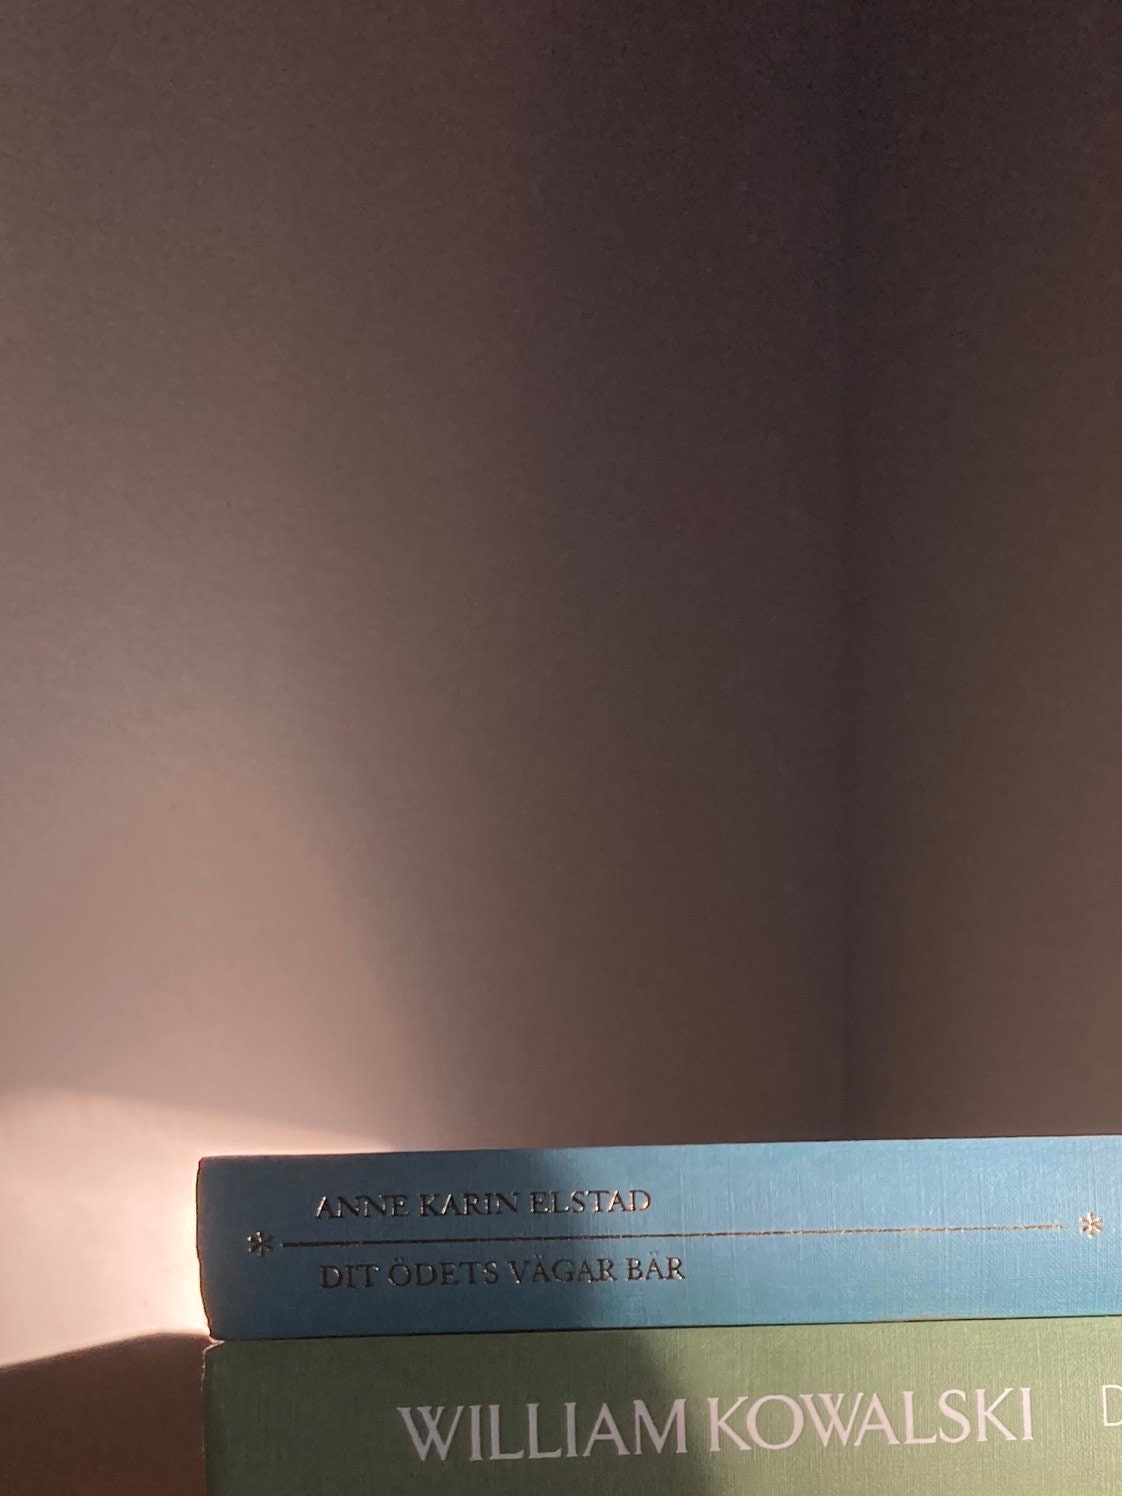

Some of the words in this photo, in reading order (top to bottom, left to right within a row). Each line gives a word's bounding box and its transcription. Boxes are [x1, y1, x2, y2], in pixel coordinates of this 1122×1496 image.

[315, 1194, 410, 1219] ANNE
[419, 1190, 519, 1217] KARIN
[530, 1188, 652, 1214] ELSTAD
[320, 1263, 380, 1290] DIT
[389, 1255, 497, 1287] ÖDETS
[507, 1253, 615, 1284] VÄGAR
[626, 1251, 687, 1281] BÄR
[397, 1398, 687, 1462] WILLIAM
[708, 1387, 1033, 1451] KOWALSKI
